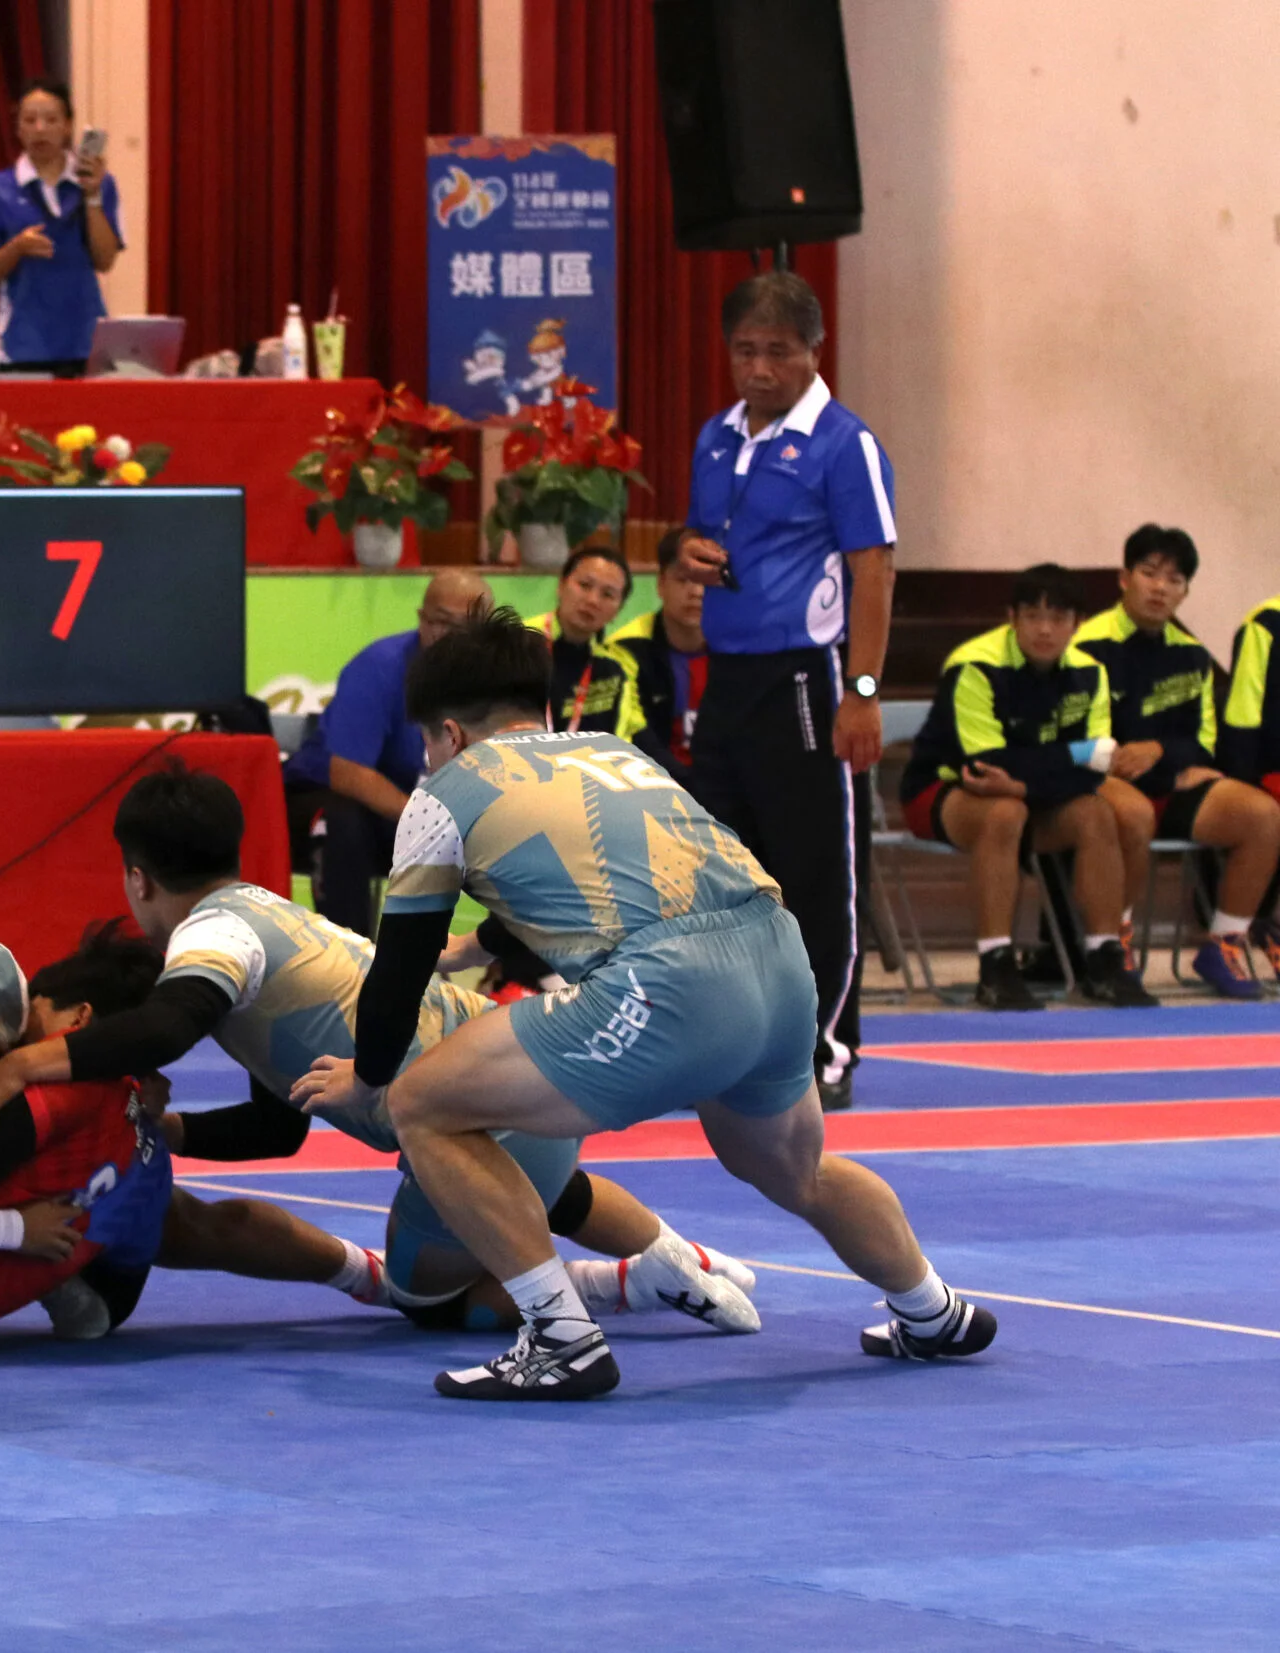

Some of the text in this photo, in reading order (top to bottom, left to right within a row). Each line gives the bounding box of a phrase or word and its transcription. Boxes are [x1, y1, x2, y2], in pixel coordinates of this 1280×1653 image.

[450, 251, 593, 298] 媒體區
[45, 540, 104, 641] 7
[556, 751, 685, 792] 12
